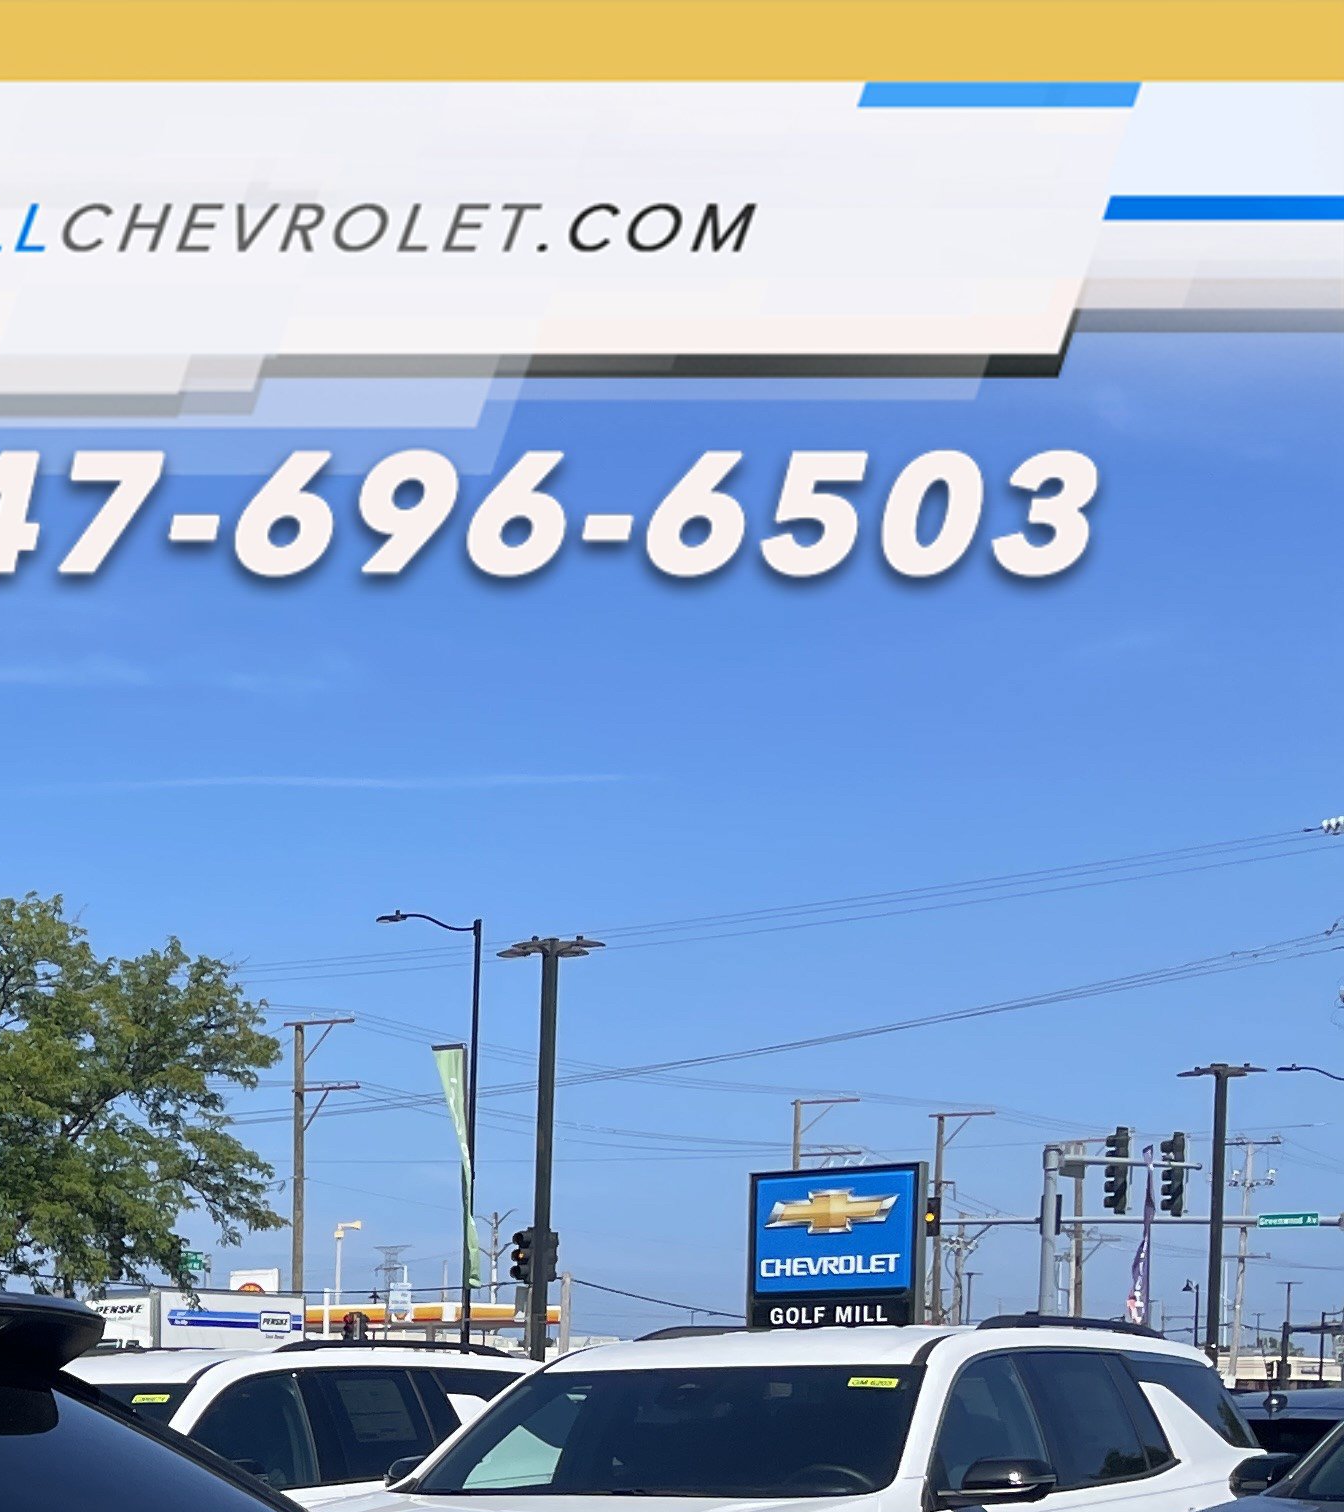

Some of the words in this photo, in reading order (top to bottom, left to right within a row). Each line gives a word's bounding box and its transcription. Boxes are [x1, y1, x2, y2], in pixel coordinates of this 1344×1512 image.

[760, 1252, 901, 1278] CHEVROLET
[95, 1304, 144, 1314] PENSKE
[769, 1307, 825, 1325] GOLF
[834, 1304, 889, 1323] MILL
